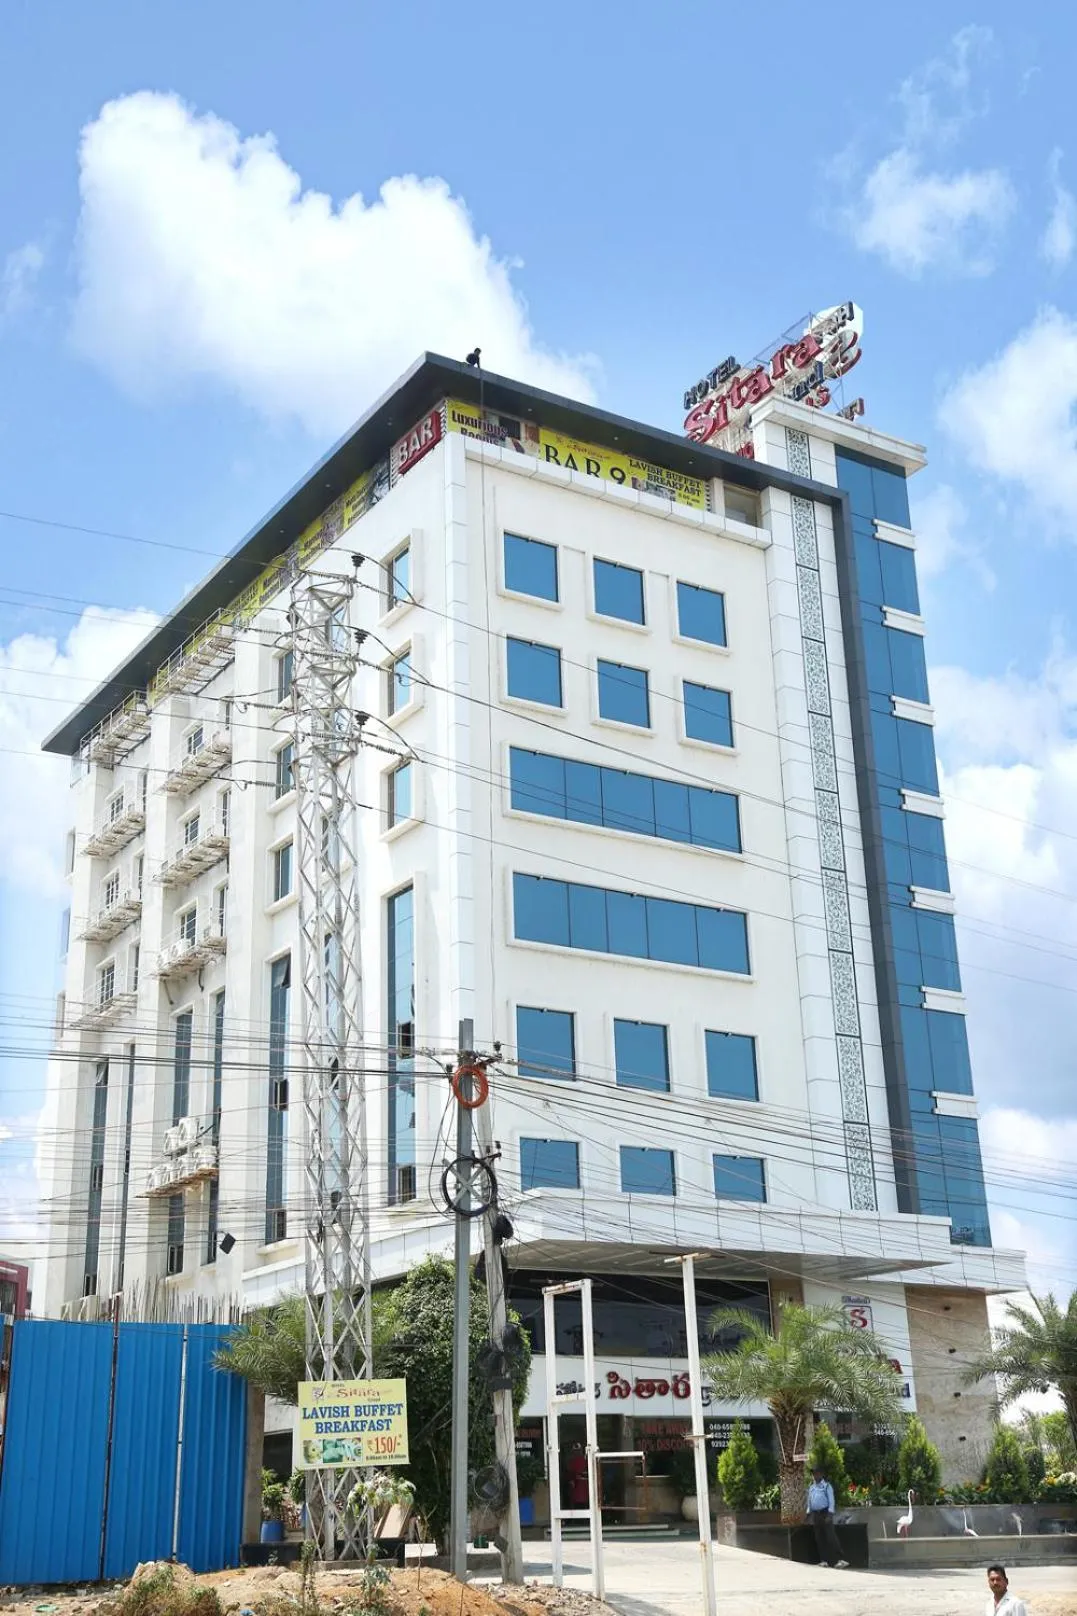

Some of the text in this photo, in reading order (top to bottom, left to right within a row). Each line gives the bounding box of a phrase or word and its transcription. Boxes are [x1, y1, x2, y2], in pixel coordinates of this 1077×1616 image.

[684, 355, 742, 410] HOTEL
[684, 333, 824, 444] Sitara
[451, 409, 509, 438] Luxurious
[397, 416, 434, 464] BAR
[543, 443, 601, 478] BAR
[629, 458, 702, 490] LAVISH BUFFET
[647, 473, 702, 497] BREAKFAST
[302, 1403, 404, 1419] LAVISH BUFFET
[315, 1418, 393, 1434] BREAKFAST
